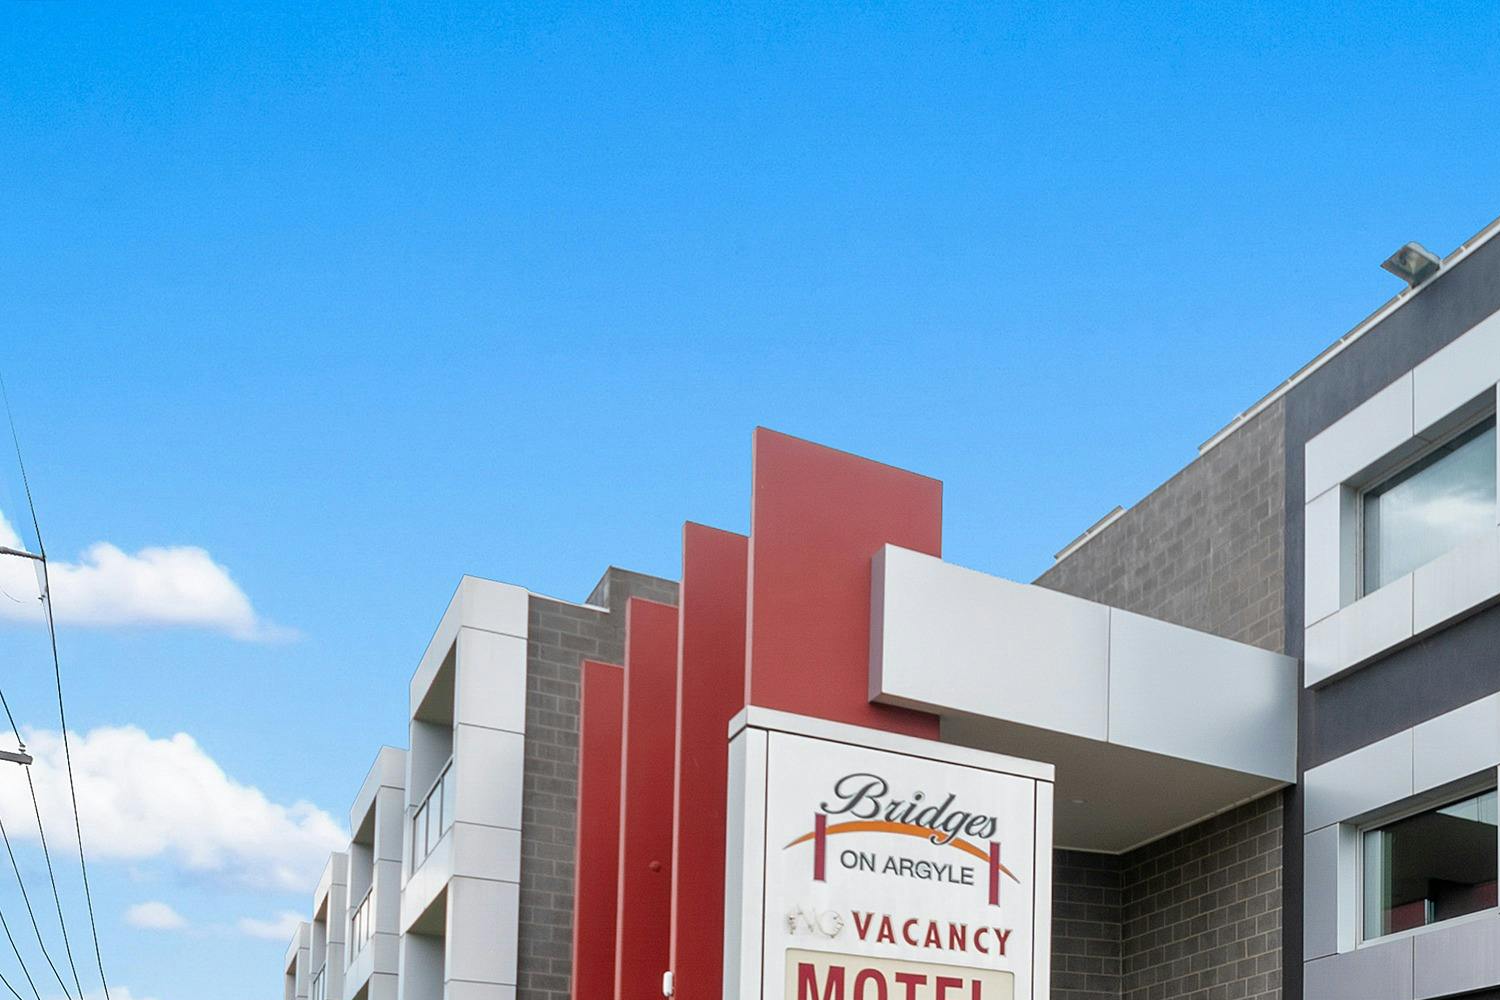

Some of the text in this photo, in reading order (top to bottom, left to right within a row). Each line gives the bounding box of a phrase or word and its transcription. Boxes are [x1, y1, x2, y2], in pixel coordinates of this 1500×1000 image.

[819, 773, 998, 846] Bridges
[840, 850, 975, 886] ON ARGYLE
[850, 910, 1013, 956] VACANCY
